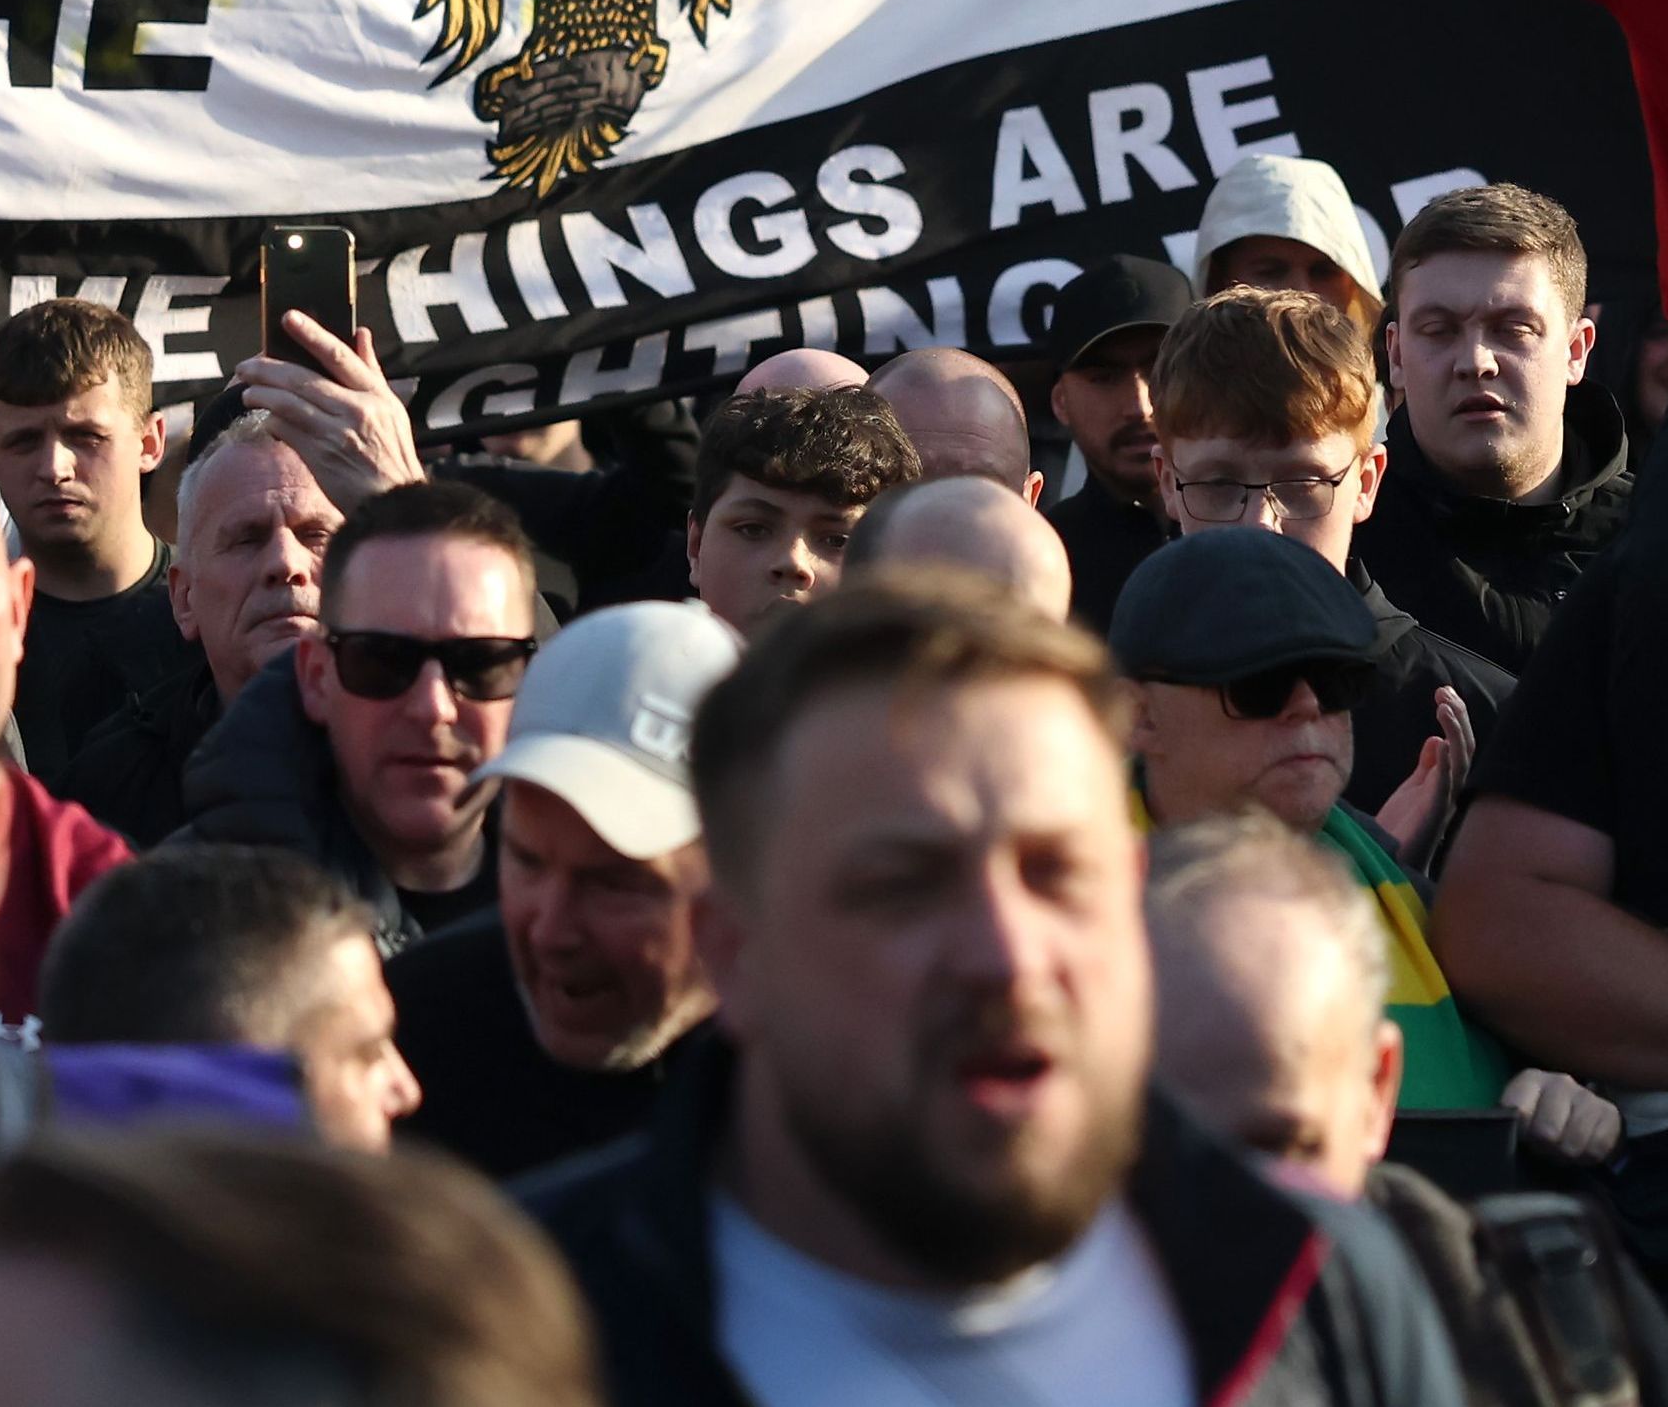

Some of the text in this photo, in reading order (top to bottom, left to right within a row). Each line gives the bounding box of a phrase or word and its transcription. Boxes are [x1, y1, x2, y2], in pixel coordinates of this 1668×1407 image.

[356, 142, 925, 345] HINGS
[990, 55, 1301, 230] ARE
[389, 257, 1089, 430] GHTING
